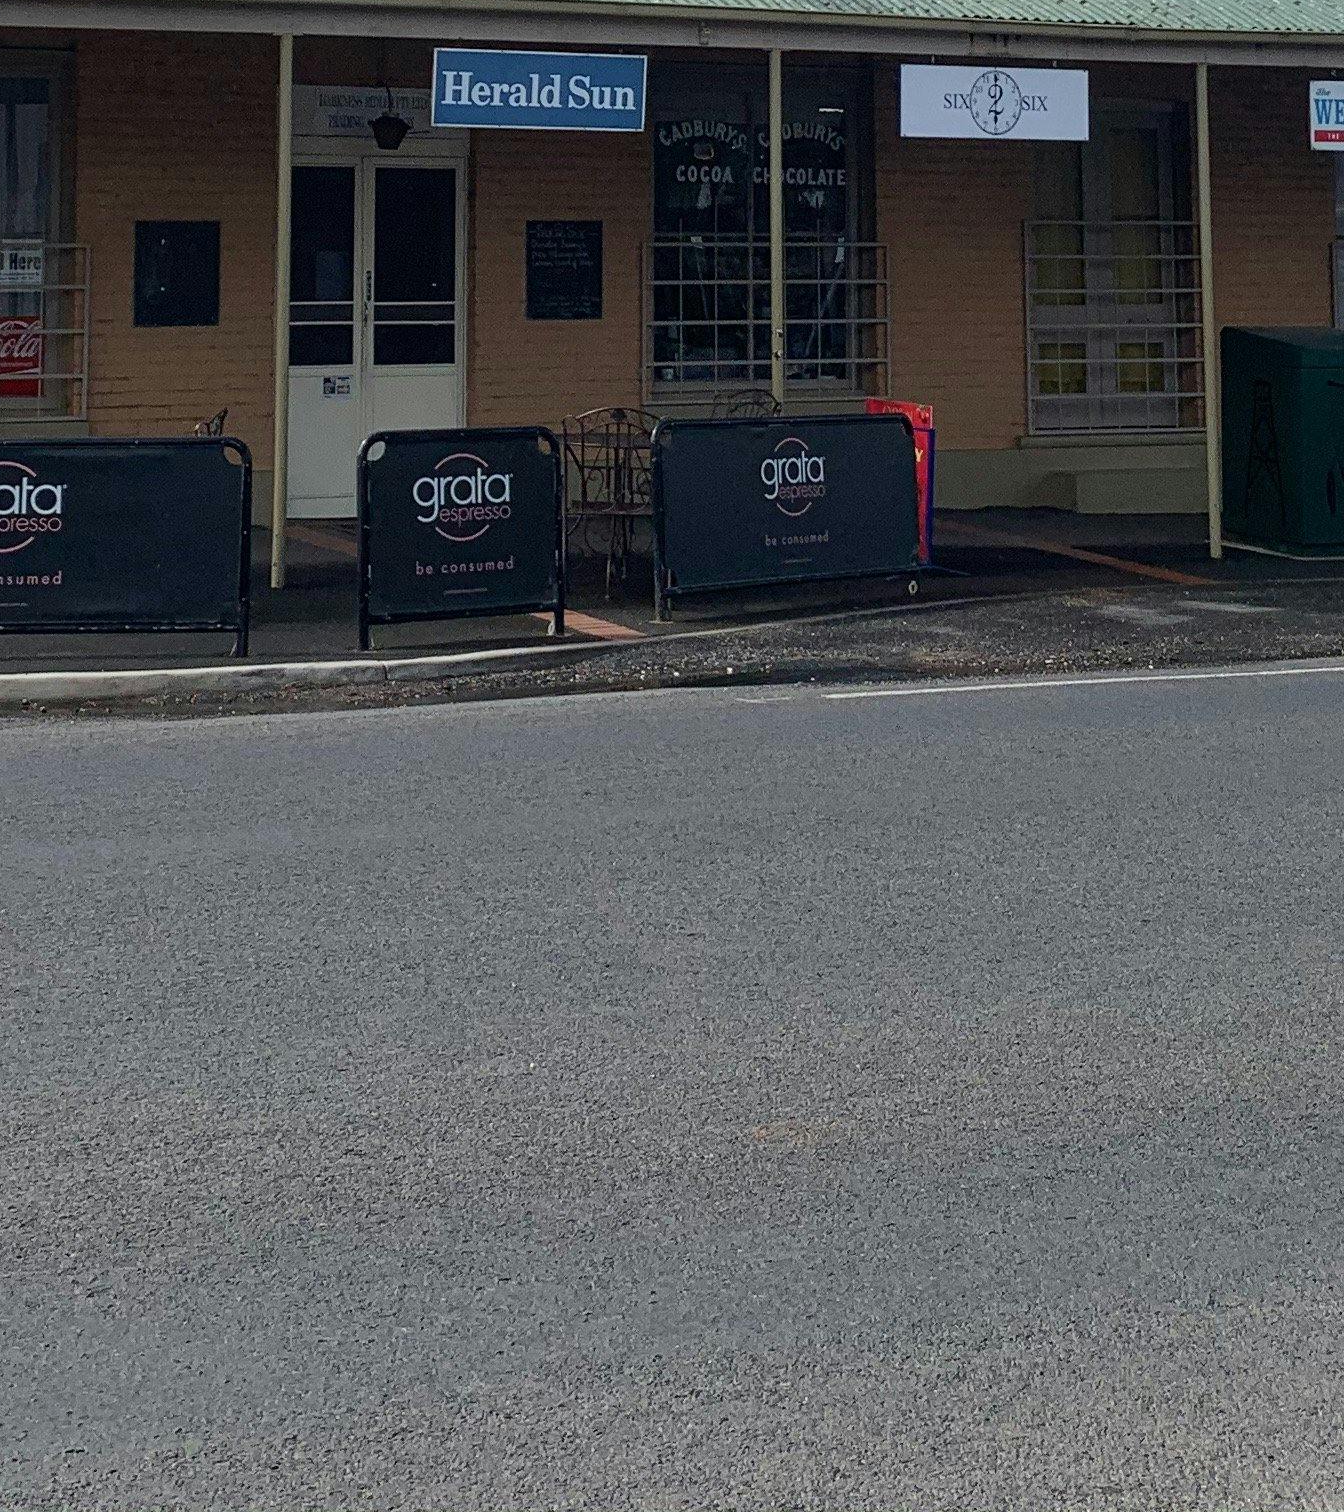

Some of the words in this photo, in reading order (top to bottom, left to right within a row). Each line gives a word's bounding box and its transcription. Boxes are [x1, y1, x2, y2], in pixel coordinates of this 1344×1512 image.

[440, 70, 562, 109] Herald
[567, 74, 637, 111] Sun
[943, 93, 970, 110] SIX
[1021, 95, 1048, 112] SIX
[758, 120, 846, 151] CDBURYS
[675, 164, 734, 184] COCOA
[752, 165, 847, 186] CHCOLATE
[8, 251, 43, 271] Here
[760, 450, 825, 500] grata
[412, 467, 511, 523] grata
[778, 484, 826, 504] espresso
[439, 505, 511, 528] espresso
[765, 534, 777, 547] be
[781, 529, 829, 546] consumed
[415, 560, 434, 576] be
[440, 554, 514, 574] consumed
